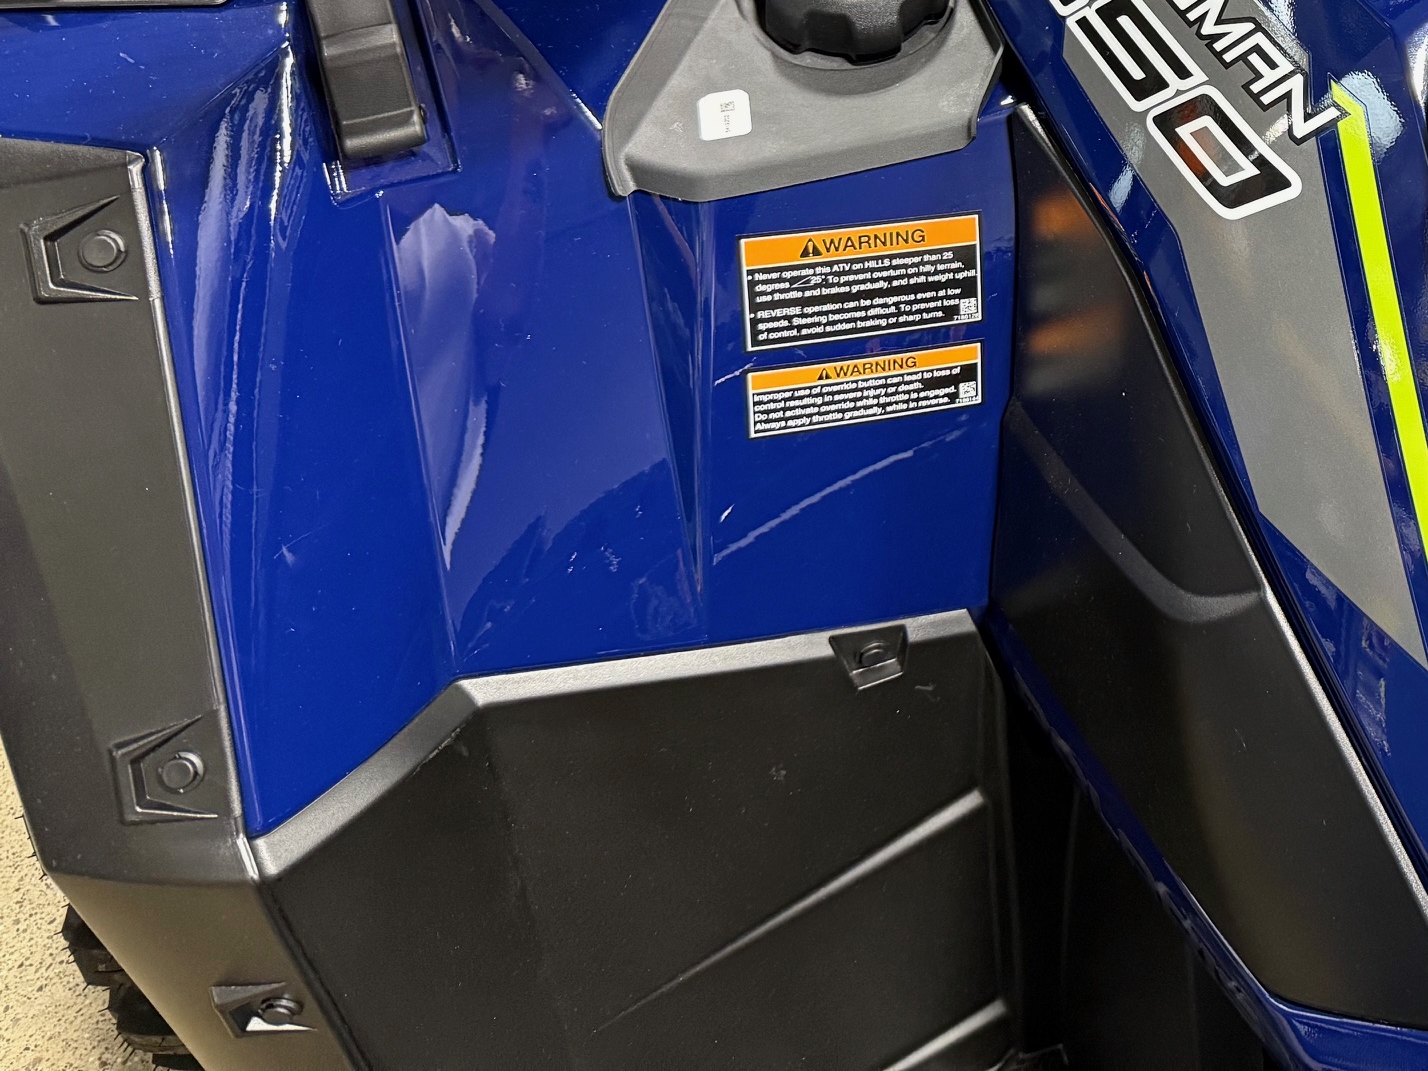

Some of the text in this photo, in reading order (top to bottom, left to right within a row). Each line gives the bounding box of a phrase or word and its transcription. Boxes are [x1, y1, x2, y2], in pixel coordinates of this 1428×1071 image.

[822, 228, 926, 254] WARNING
[754, 250, 954, 281] Never operate this ATV on HILLS steeper than 25
[755, 281, 791, 293] degrees
[827, 274, 840, 284] To
[839, 271, 872, 284] prevent
[871, 268, 907, 279] overturn
[906, 266, 919, 275] on
[919, 263, 936, 274] hilly
[755, 294, 773, 303] use
[772, 290, 804, 301] throttle
[803, 287, 821, 298] and
[821, 285, 851, 296] brakes
[892, 277, 909, 287] and
[909, 274, 927, 285] shift
[927, 271, 954, 283] weight
[756, 287, 962, 319] REVERSE operation can be dangerous even at low
[792, 314, 828, 326] Steering
[828, 310, 867, 322] becomes
[899, 303, 911, 312] To
[911, 299, 943, 312] prevent
[942, 298, 961, 307] loss
[757, 331, 768, 341] of
[801, 324, 825, 336] avoid
[824, 321, 856, 333] sudden
[856, 317, 887, 329] braking
[887, 316, 898, 324] or
[897, 313, 922, 323] sharp
[833, 356, 917, 378] WARNING
[753, 365, 961, 403] Improper use of override button can lead to loss of
[753, 400, 785, 413] control
[785, 396, 825, 408] resulting
[824, 394, 834, 403] in
[833, 390, 863, 402] severe
[862, 387, 889, 397] injury
[888, 385, 898, 394] or
[754, 412, 768, 422] Do
[768, 410, 785, 420] not
[784, 405, 820, 418] activate
[819, 400, 855, 413] override
[855, 397, 879, 408] while
[878, 392, 910, 405] throttle
[910, 391, 919, 400] is
[754, 420, 787, 431] Always
[786, 416, 811, 428] apply
[811, 411, 843, 424] throttle
[885, 402, 909, 413] while
[908, 400, 918, 409] in
